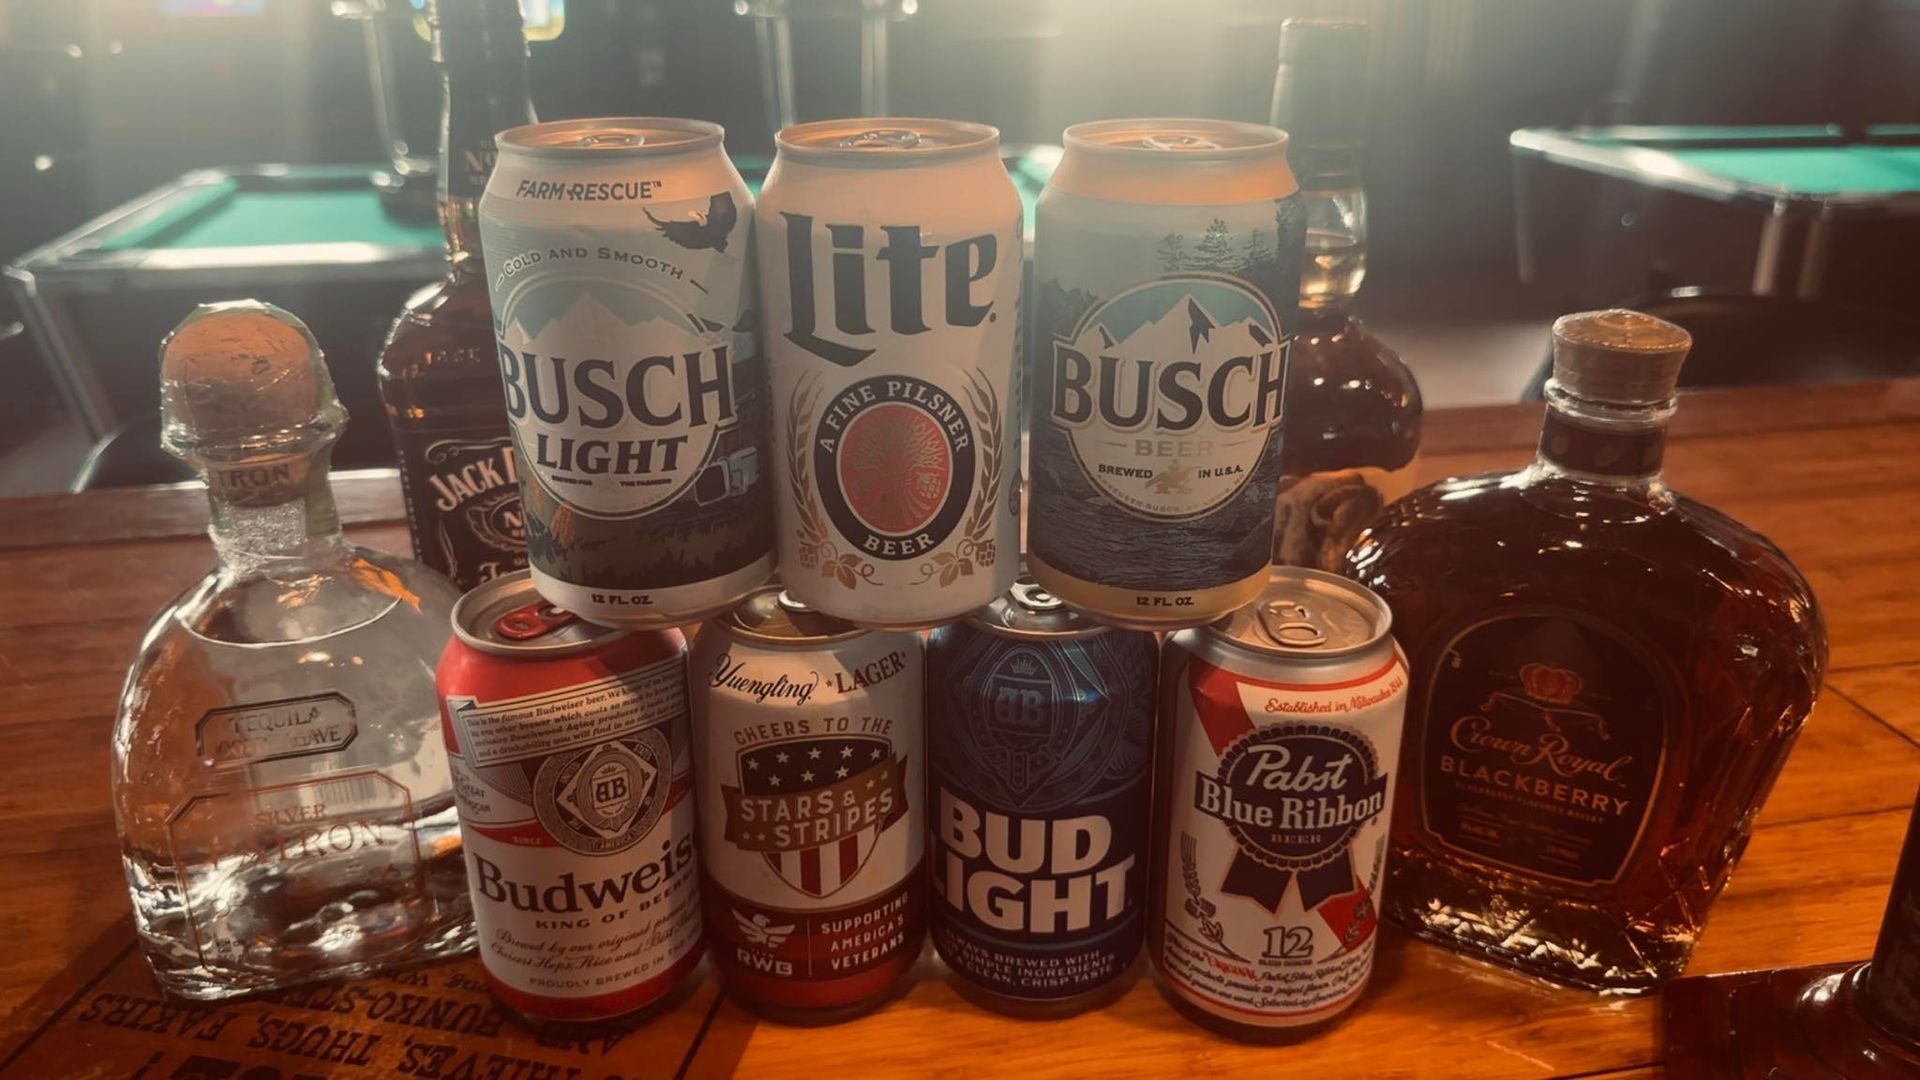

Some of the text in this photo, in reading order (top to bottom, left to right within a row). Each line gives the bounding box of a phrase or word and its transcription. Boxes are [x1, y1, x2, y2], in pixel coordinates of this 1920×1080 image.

[503, 247, 684, 280] COLD AND SMOOTH
[780, 211, 997, 367] Lite
[500, 343, 735, 429] BUSCH
[1053, 341, 1290, 431] BUSCH
[820, 380, 969, 454] A FINE PILSNER
[536, 433, 689, 474] LIGHT
[1135, 439, 1214, 457] BEER
[429, 457, 506, 511] JACK
[1098, 464, 1154, 479] BREWED
[1198, 469, 1212, 479] IN
[864, 532, 935, 556] BEER
[591, 593, 605, 604] 12
[1137, 596, 1150, 606] 12
[708, 651, 907, 706] Yuengling LAGER
[536, 699, 584, 717] Budweiser
[1265, 698, 1332, 713] Established
[1335, 701, 1350, 712] in
[734, 716, 893, 746] CHEERS TO THE
[1450, 715, 1532, 756] Crown
[1248, 744, 1354, 793] Pabst
[1440, 754, 1632, 817] BLACKBERRY
[255, 803, 327, 826] SILVER
[740, 789, 856, 823] STARS &
[774, 787, 893, 848] STRIPES
[1200, 778, 1383, 830] Blue Ribbon
[940, 786, 1112, 875] BUD
[535, 918, 591, 930] KING
[601, 909, 630, 924] OF
[820, 890, 909, 935] SUPPORTING
[831, 931, 904, 971] VETERANS
[994, 953, 1060, 968] BREWED
[1065, 949, 1100, 966] WITH
[1262, 926, 1314, 960] 12
[529, 977, 591, 989] PROUDLY
[595, 964, 650, 986] BREWED
[652, 954, 665, 967] IN
[737, 947, 793, 977] RWB
[1020, 975, 1069, 988] CRISP
[76, 994, 240, 1043] FAKIRS
[245, 1010, 383, 1067] THUGS,
